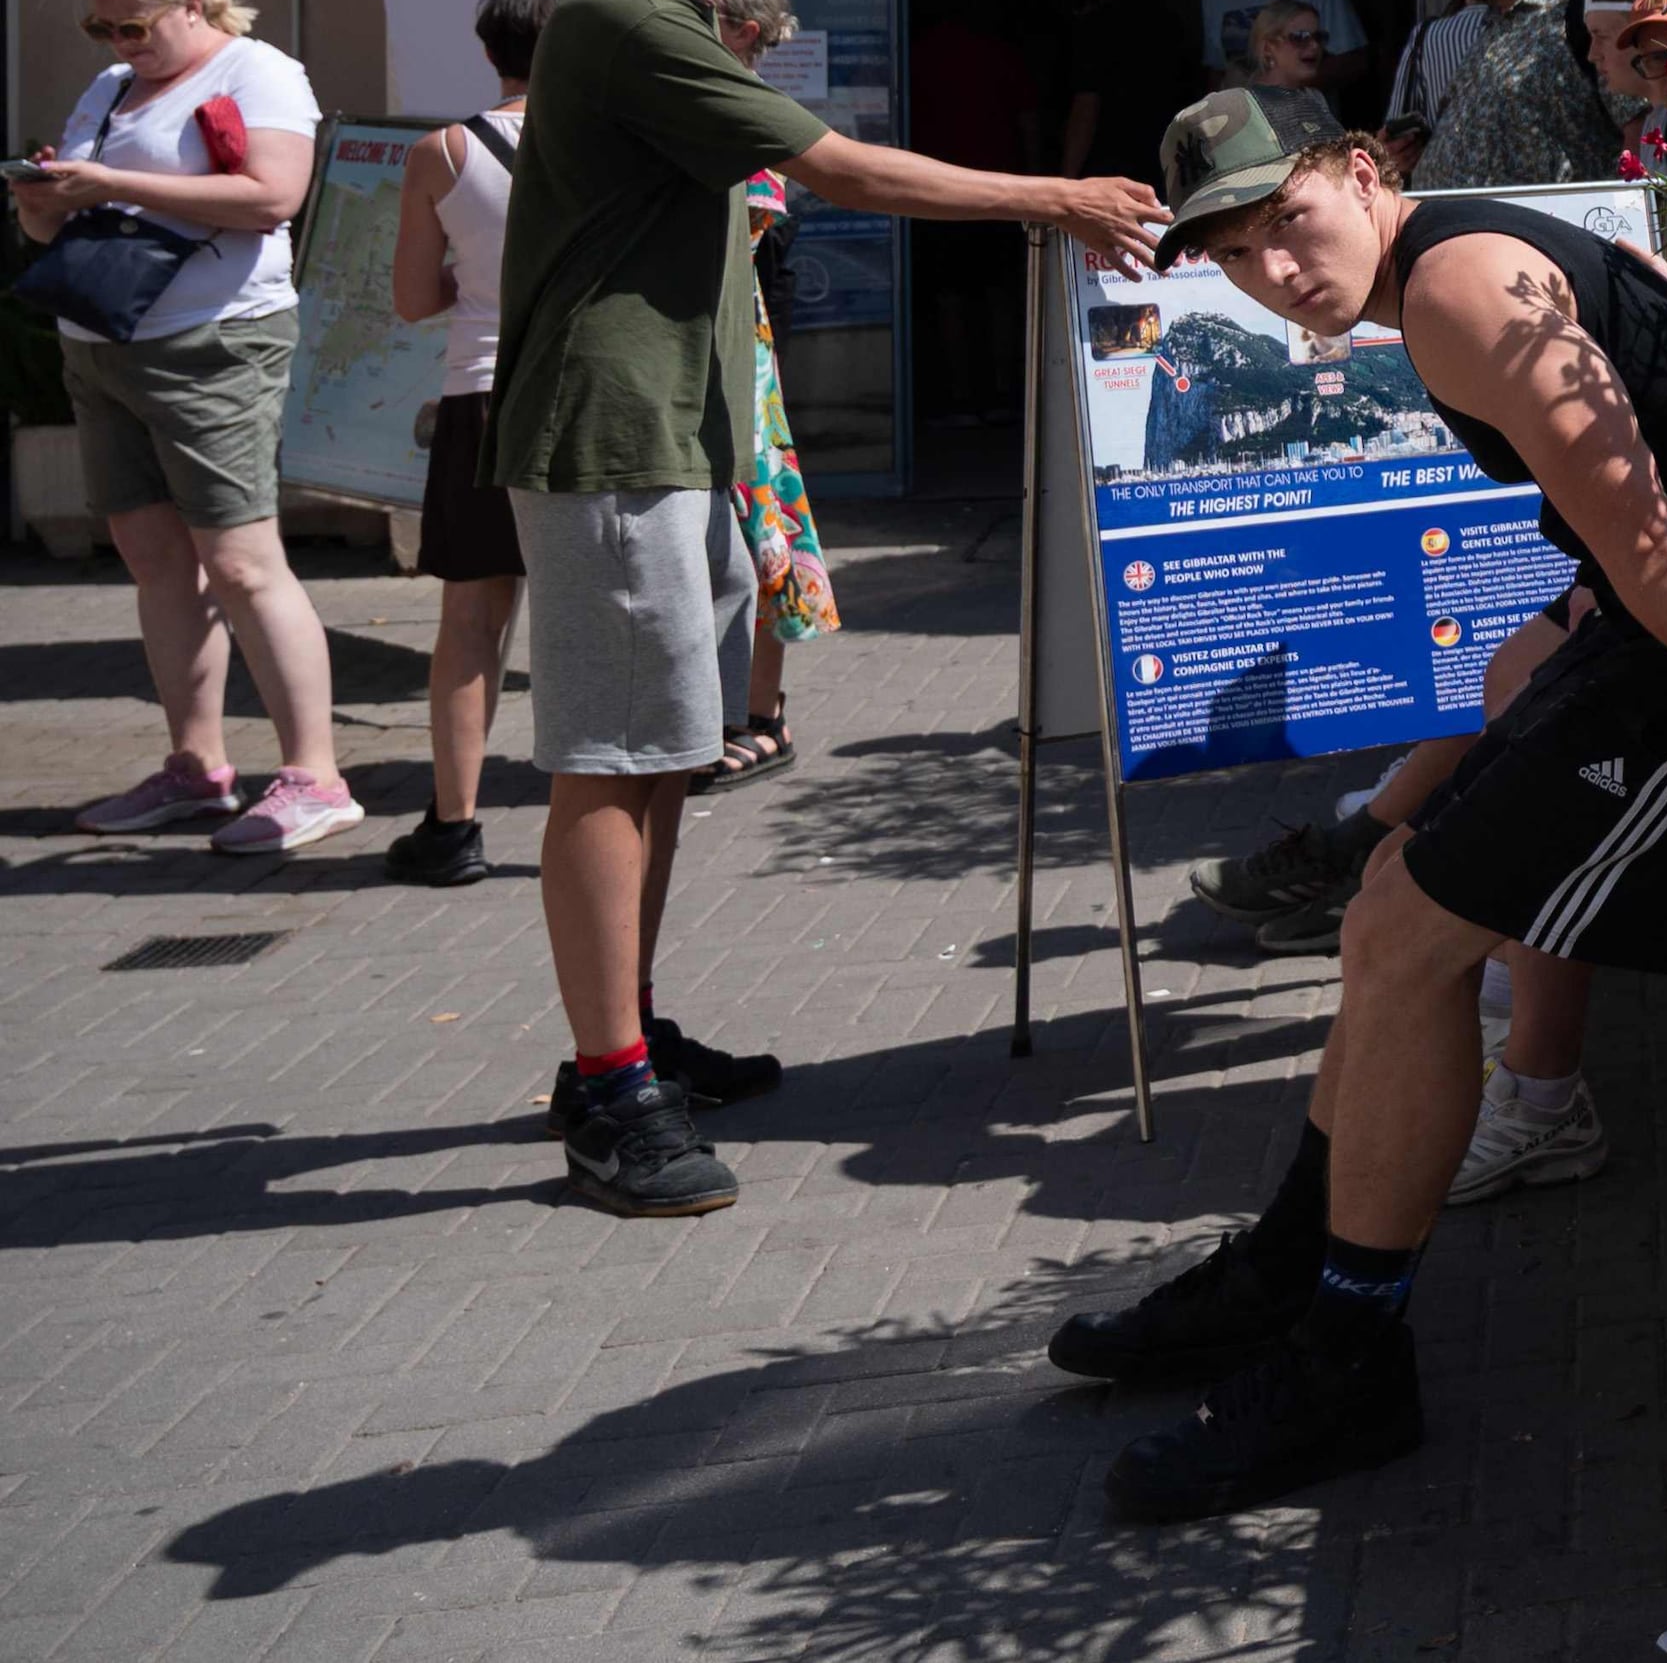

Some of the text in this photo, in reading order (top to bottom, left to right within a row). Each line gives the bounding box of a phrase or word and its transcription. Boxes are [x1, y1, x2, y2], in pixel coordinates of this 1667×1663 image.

[336, 140, 385, 165] WELCOME
[1111, 465, 1364, 501] THE ONLY TRANSPORT THAT CAN TAKE YOU TO
[1381, 469, 1411, 488] THE
[1415, 465, 1455, 485] BEST
[1169, 489, 1312, 517] THE HIGHEST POINT!
[1459, 519, 1539, 537] VISITE GIBRALTAR
[1461, 531, 1544, 550] GENTE QUE ENTIE
[1163, 548, 1286, 571] SEE GIBRALTAR WITH THE
[1164, 564, 1264, 585] PEOPLE WHO KNOW
[1471, 613, 1521, 629] LASSEN SIE
[1472, 628, 1506, 642] DENEN
[1171, 641, 1280, 664] VISITEZ GIBRALTAR EN
[1172, 651, 1300, 678] COMPAGNIE DES EXPERTS
[1578, 766, 1628, 797] adidas
